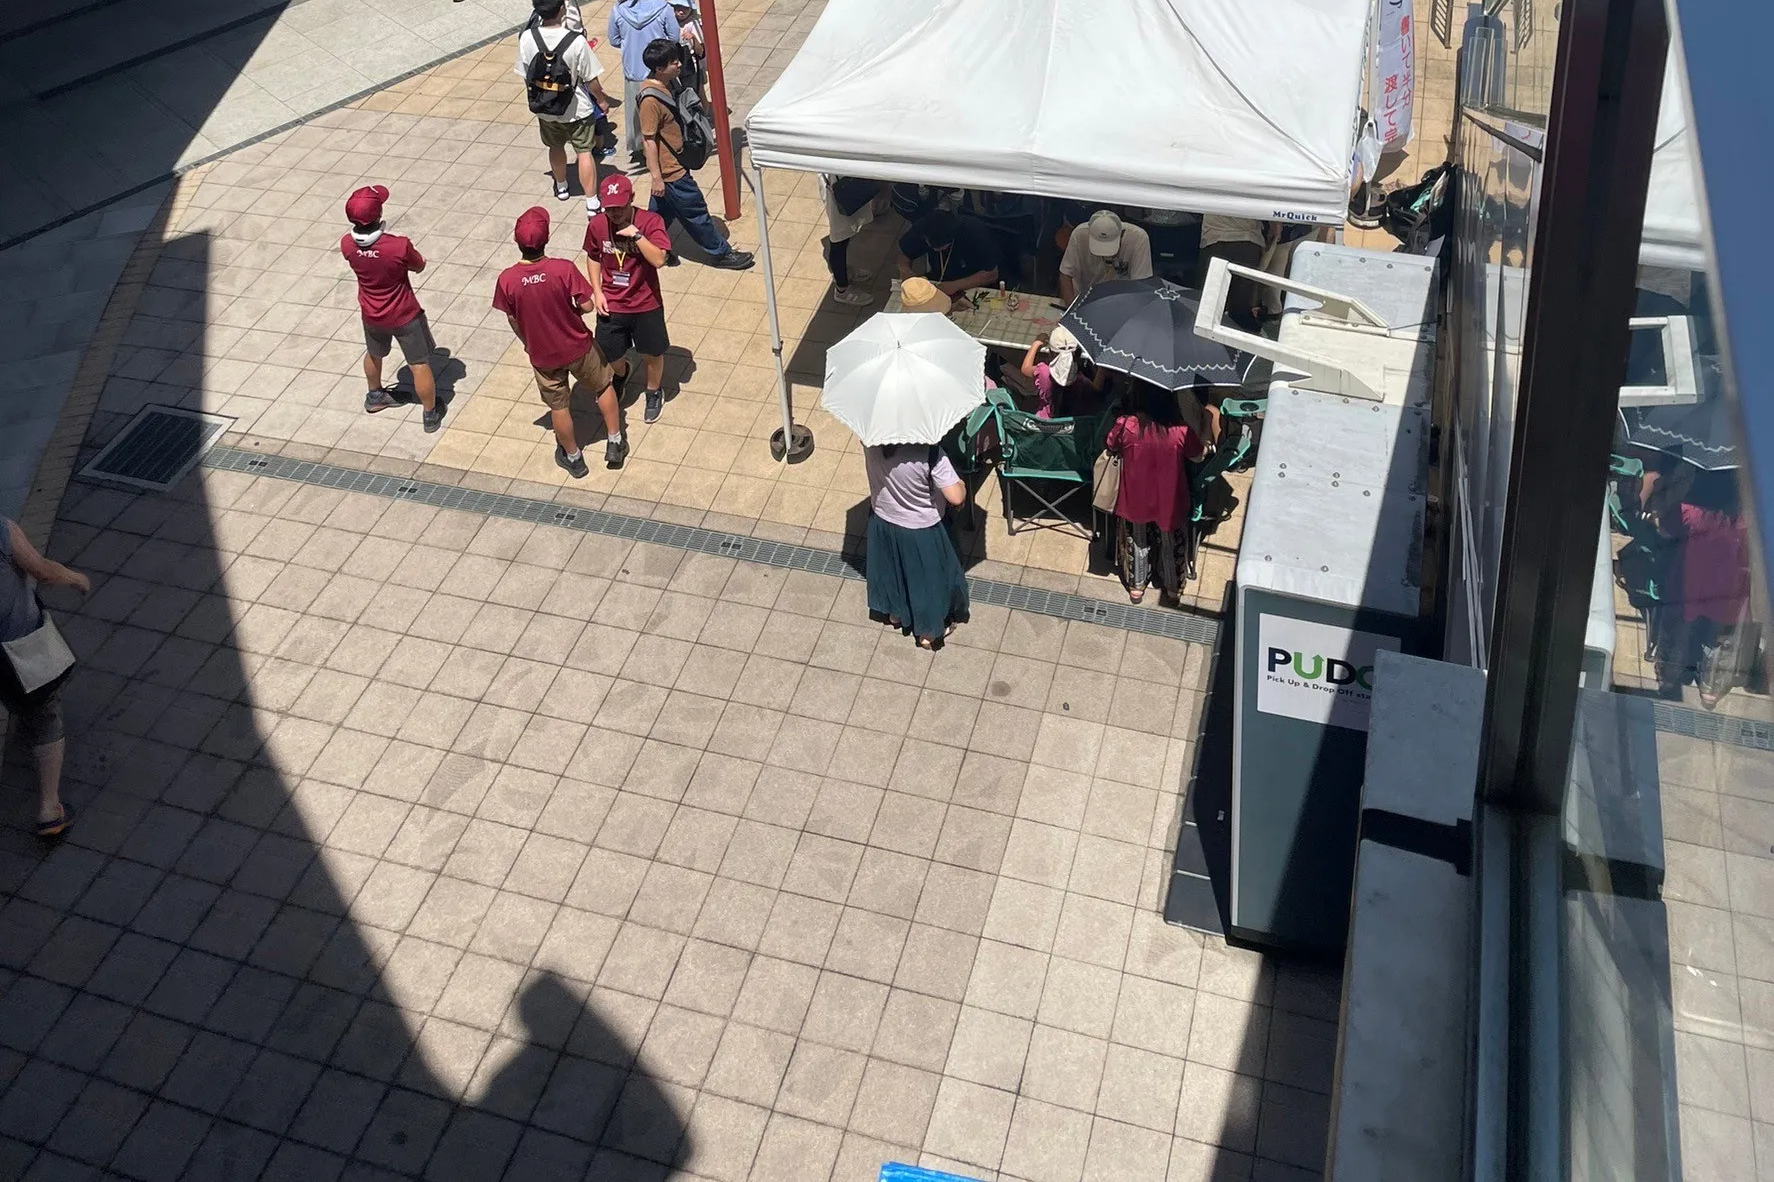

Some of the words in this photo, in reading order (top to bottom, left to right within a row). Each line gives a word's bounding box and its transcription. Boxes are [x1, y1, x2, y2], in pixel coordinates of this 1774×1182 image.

[1272, 211, 1318, 222] MrQuick
[521, 272, 547, 286] MBC
[1266, 674, 1285, 684] Pick
[1288, 678, 1301, 687] Up
[1303, 681, 1311, 689] &
[1312, 683, 1336, 694] Drop
